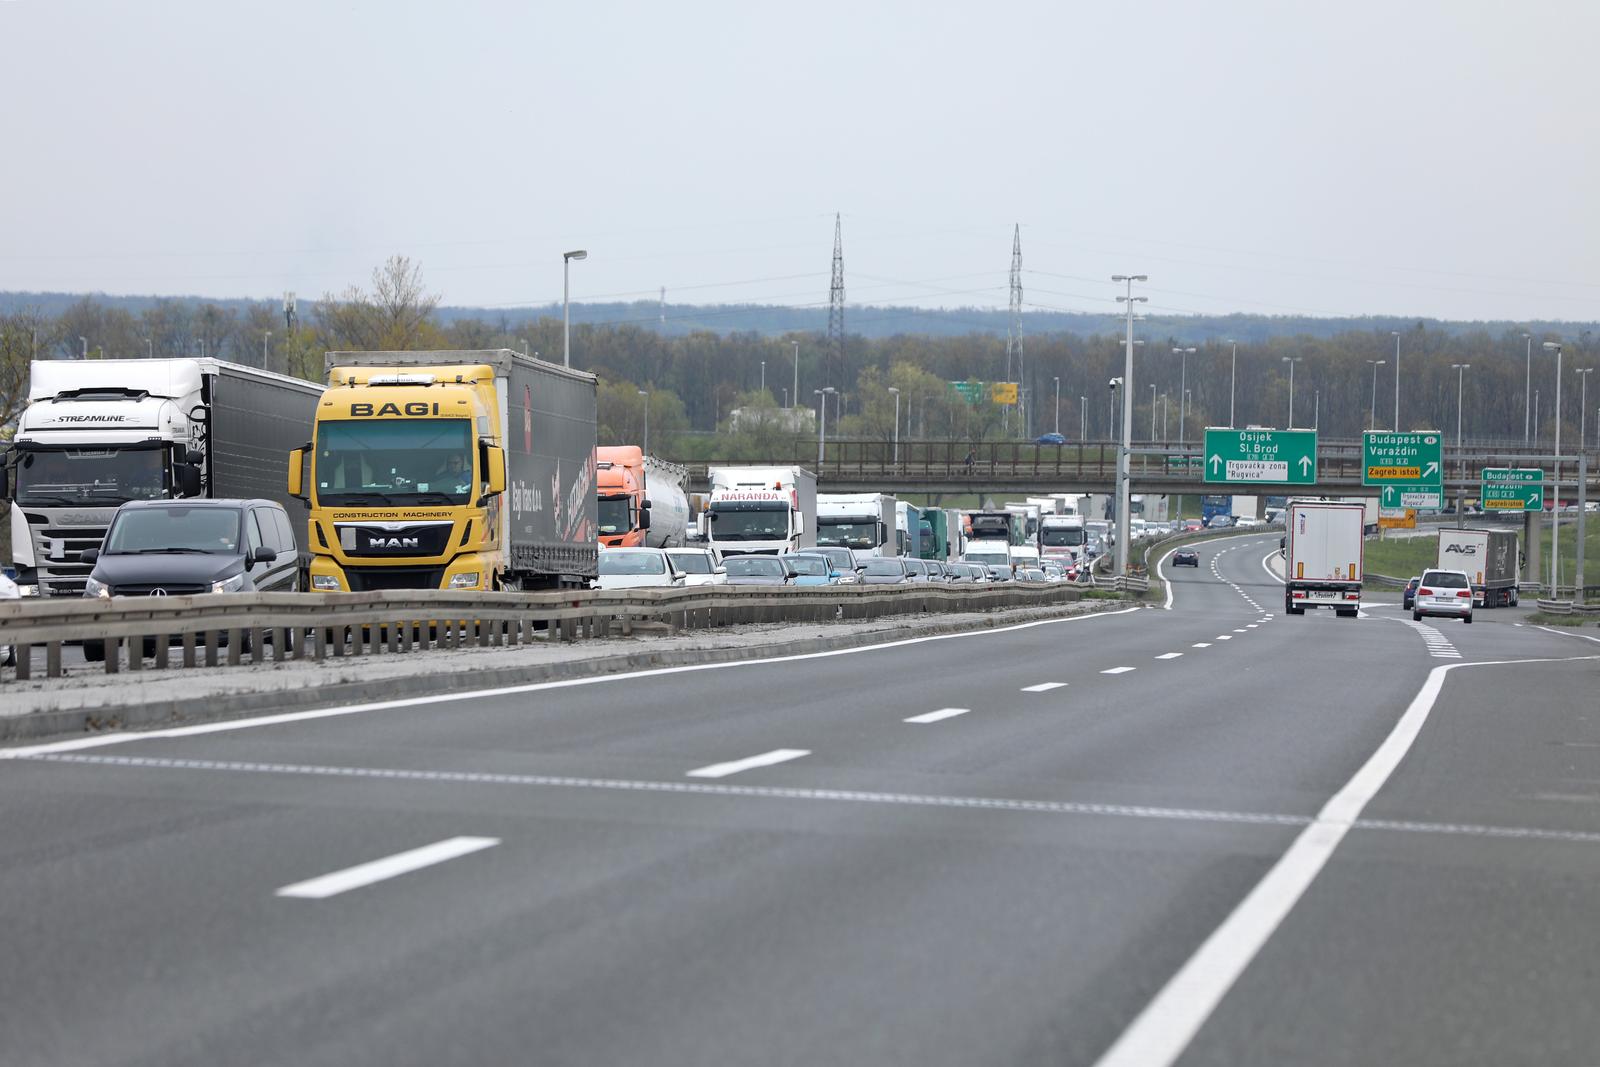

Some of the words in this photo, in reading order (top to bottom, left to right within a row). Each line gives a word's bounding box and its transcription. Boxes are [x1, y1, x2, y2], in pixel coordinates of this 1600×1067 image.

[350, 402, 439, 417] BAGI
[58, 415, 126, 423] STREAMLINE
[1240, 432, 1272, 443] Osijek
[1369, 434, 1421, 445] Budapest
[1254, 444, 1278, 453] Brod
[1369, 446, 1418, 456] Varaždin
[1228, 470, 1264, 479] "Rugvica"
[1368, 467, 1397, 477] Zagreb
[1400, 468, 1420, 476] istok
[1486, 472, 1524, 480] Budapest
[369, 537, 418, 548] MAN
[1445, 544, 1476, 554] AVS
